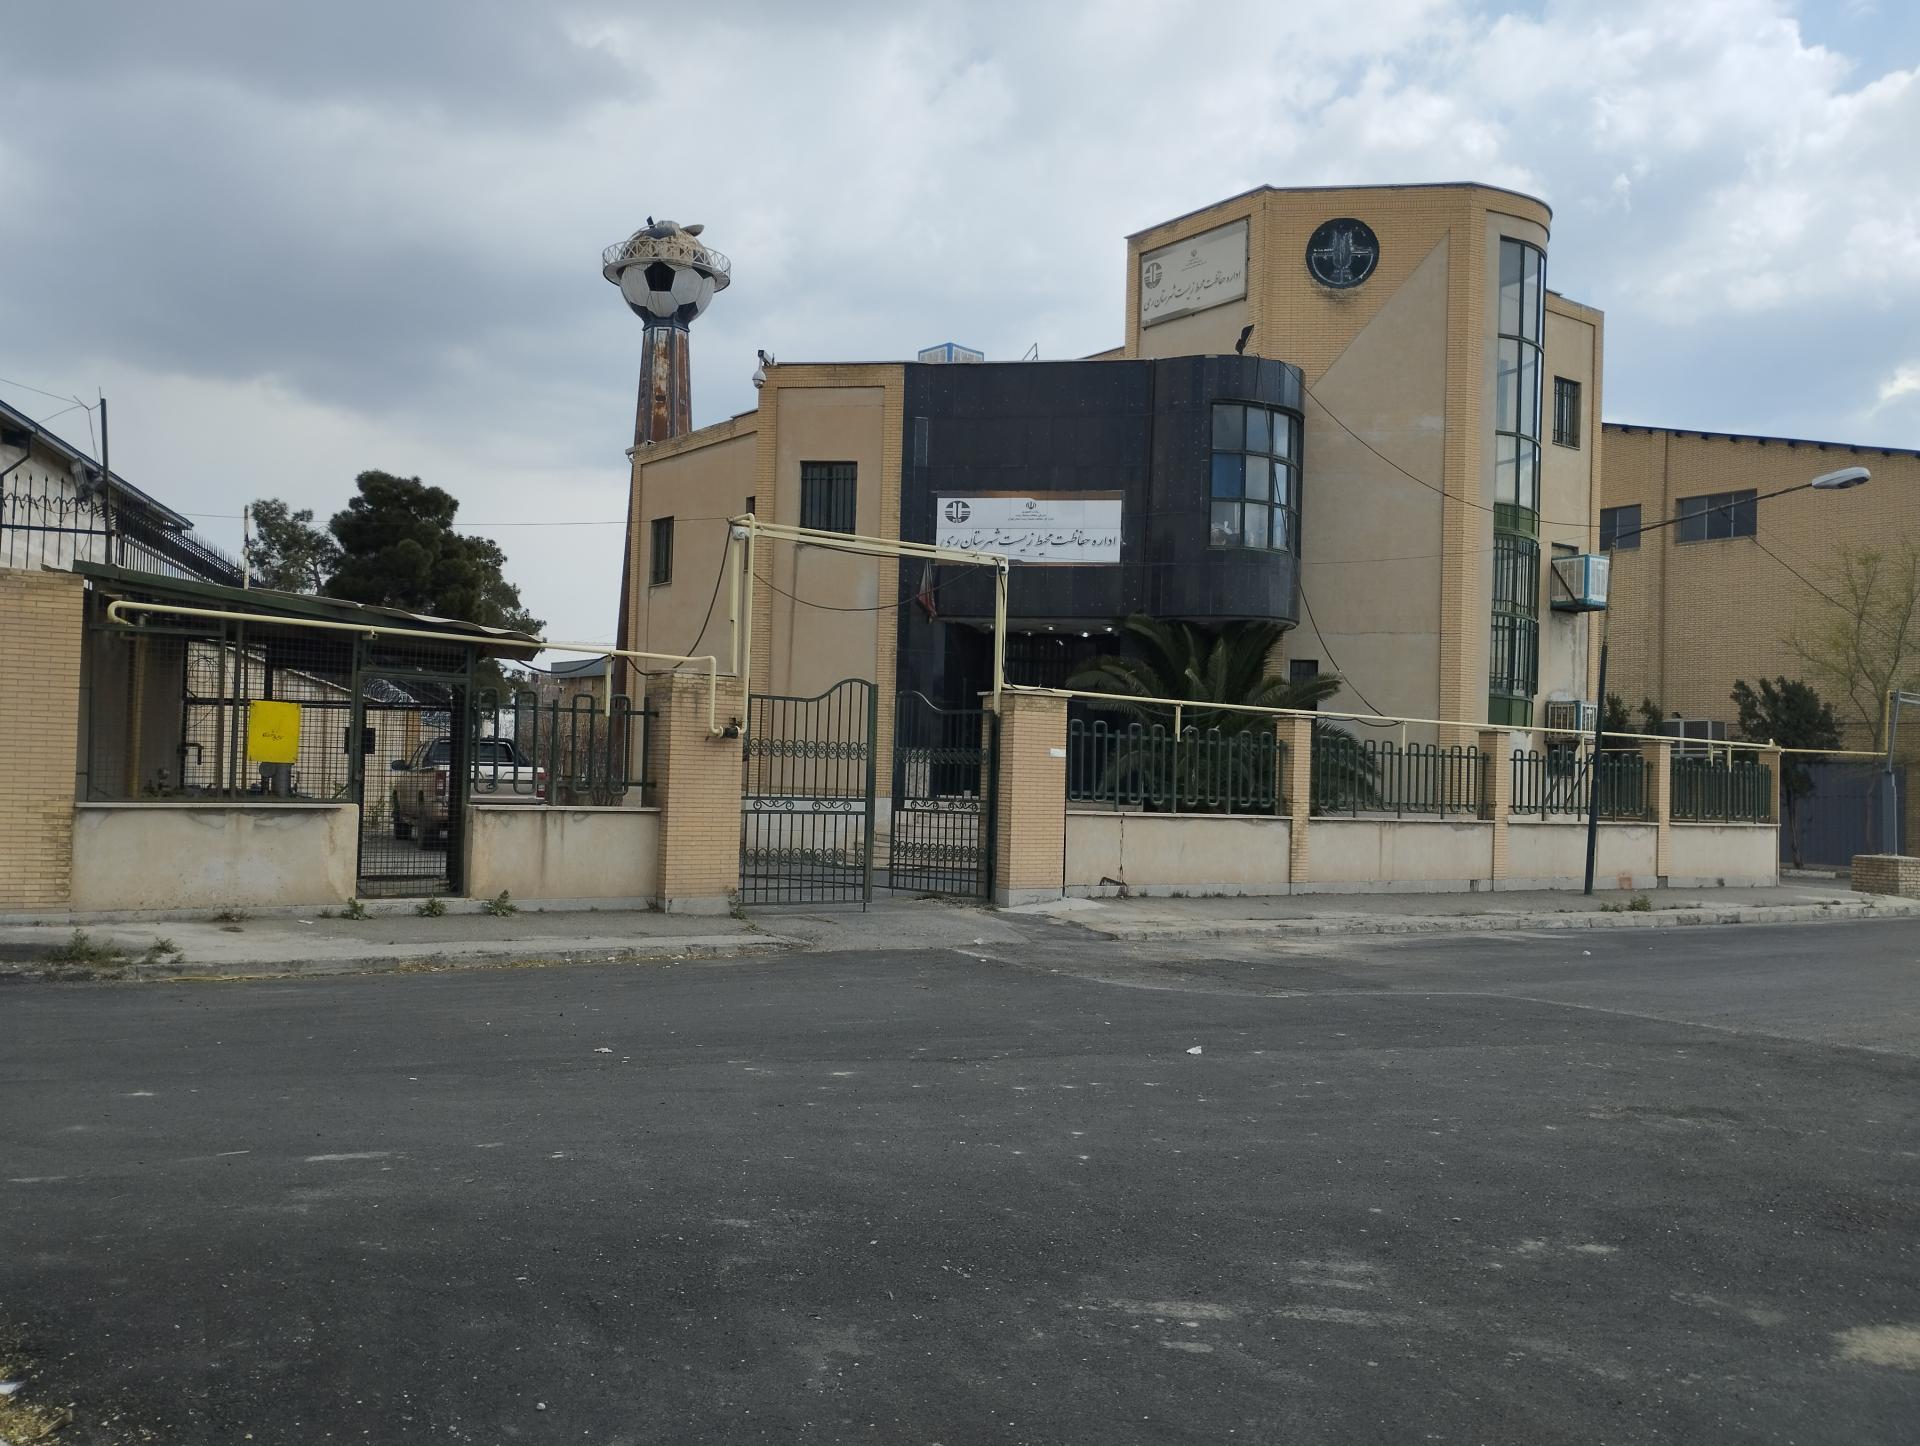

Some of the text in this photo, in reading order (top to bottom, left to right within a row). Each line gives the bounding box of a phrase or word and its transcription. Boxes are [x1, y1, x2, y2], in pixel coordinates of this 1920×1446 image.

[940, 528, 1116, 556] اداره حفاظت محیط زیست شهرستان ری
